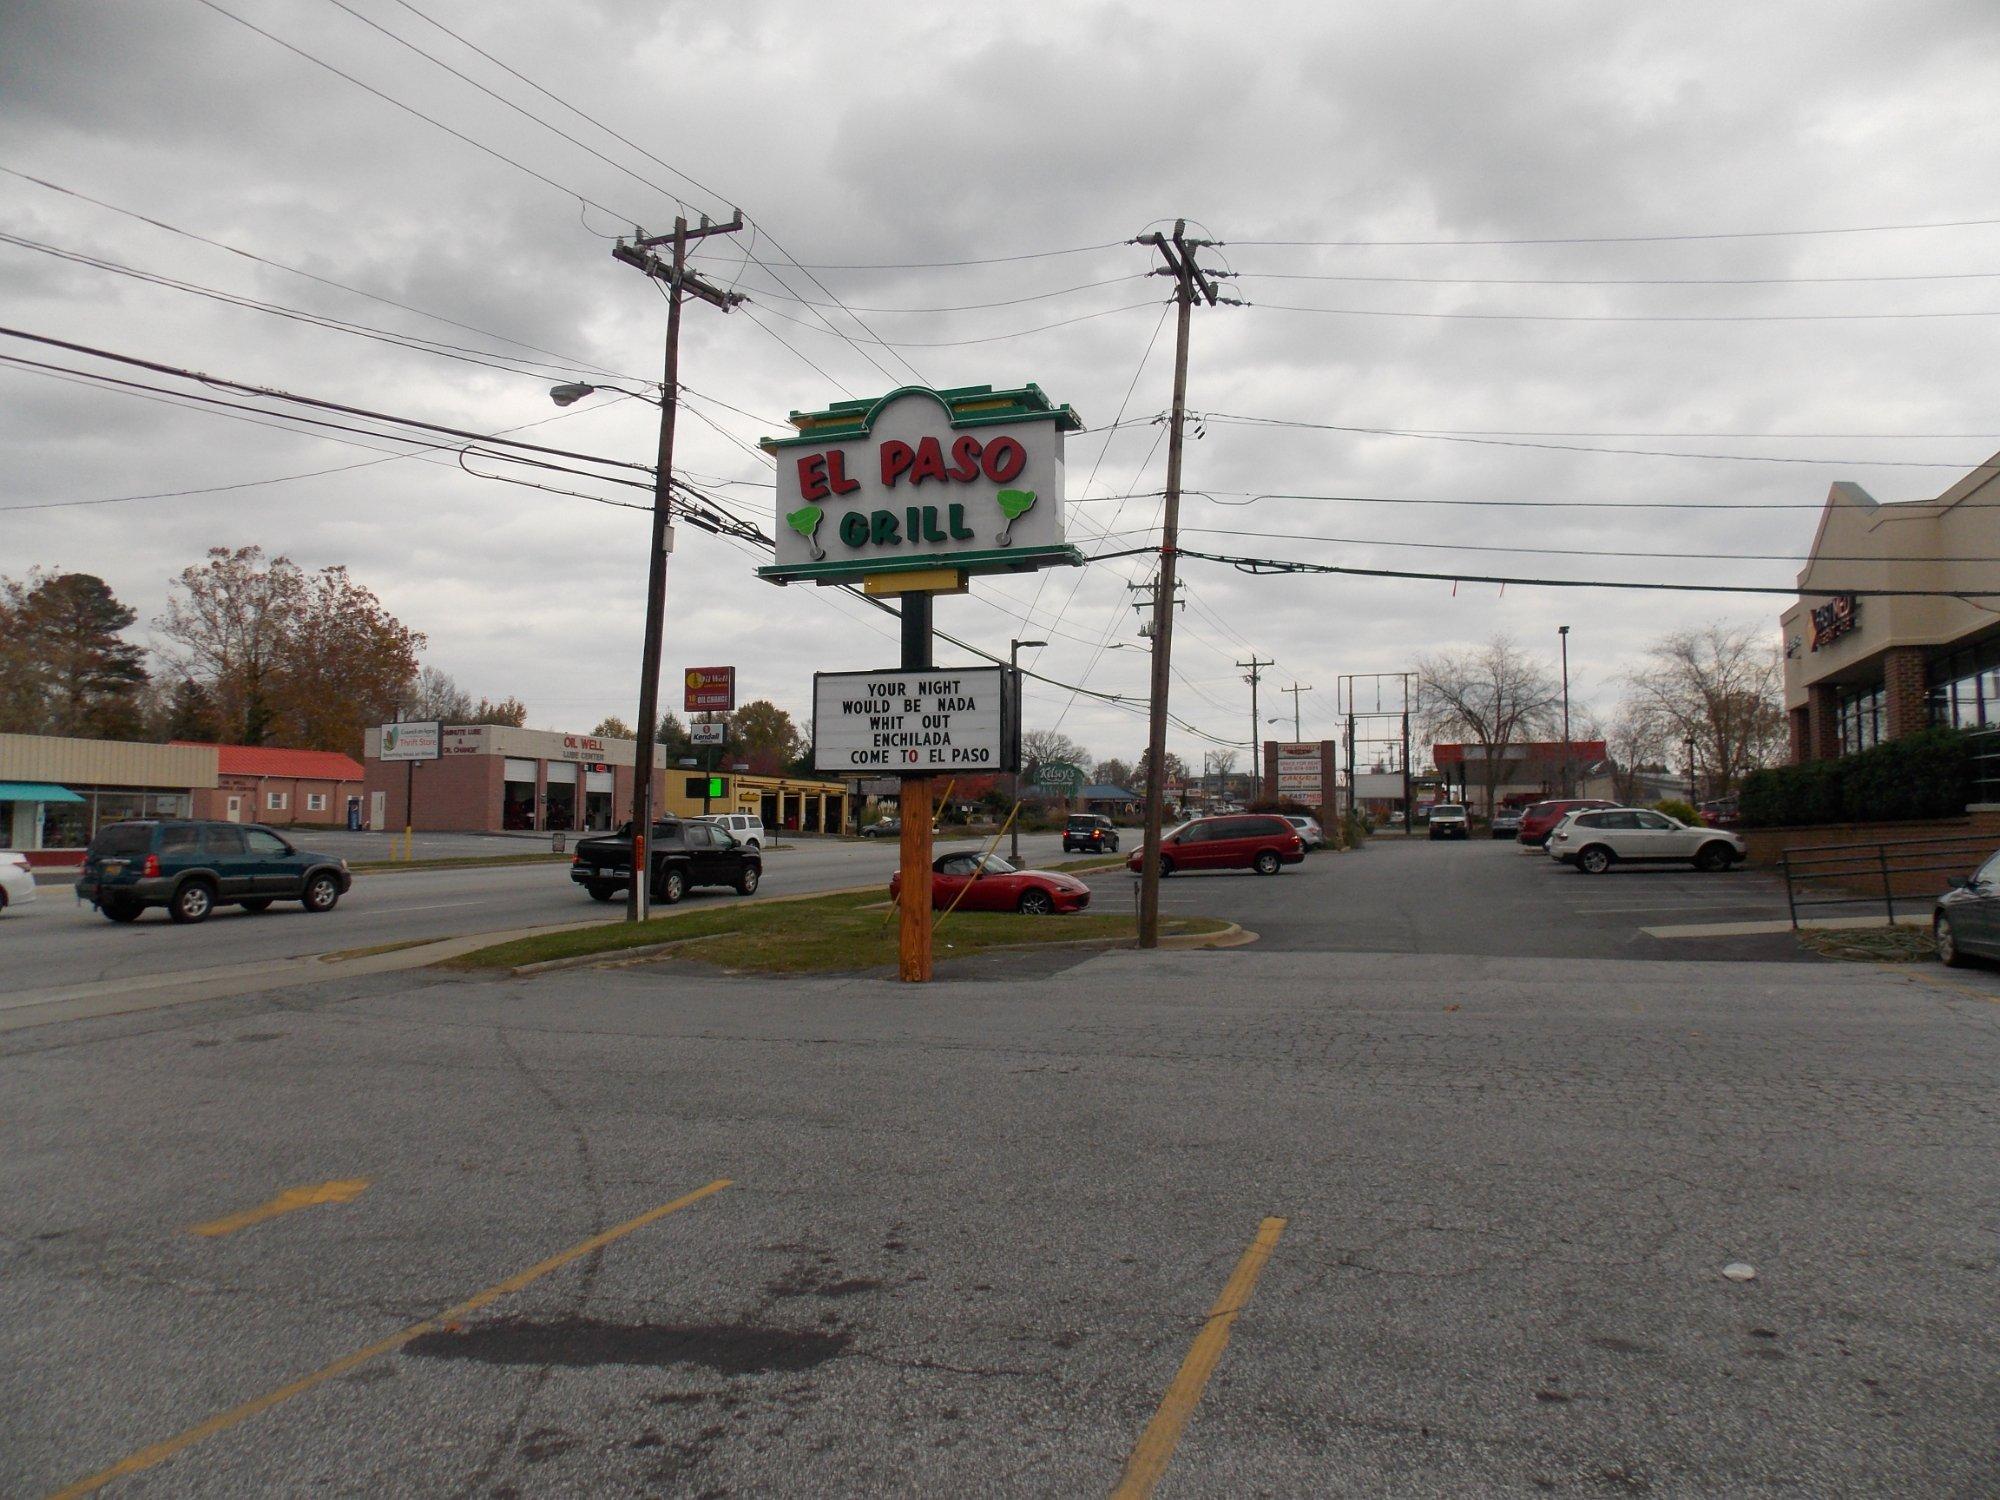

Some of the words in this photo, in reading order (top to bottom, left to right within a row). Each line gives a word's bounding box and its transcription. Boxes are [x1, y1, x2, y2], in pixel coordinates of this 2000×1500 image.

[797, 449, 861, 502] EL
[880, 435, 1027, 487] PASO
[839, 503, 975, 548] GRILL
[868, 682, 906, 697] YOUR
[918, 680, 961, 696] NIGHT
[842, 700, 890, 714] WOULD
[904, 699, 921, 713] BE
[938, 697, 976, 712] NADA
[870, 716, 904, 730] WHIT
[922, 715, 951, 729] OUT
[419, 738, 437, 746] Store
[693, 732, 720, 740] Kendall
[874, 732, 952, 747] ENCHILADA
[564, 737, 578, 748] OIL
[581, 738, 604, 751] WELL
[850, 750, 889, 764] COME
[900, 750, 918, 764] TO
[930, 749, 945, 763] EL
[952, 748, 990, 762] PASO
